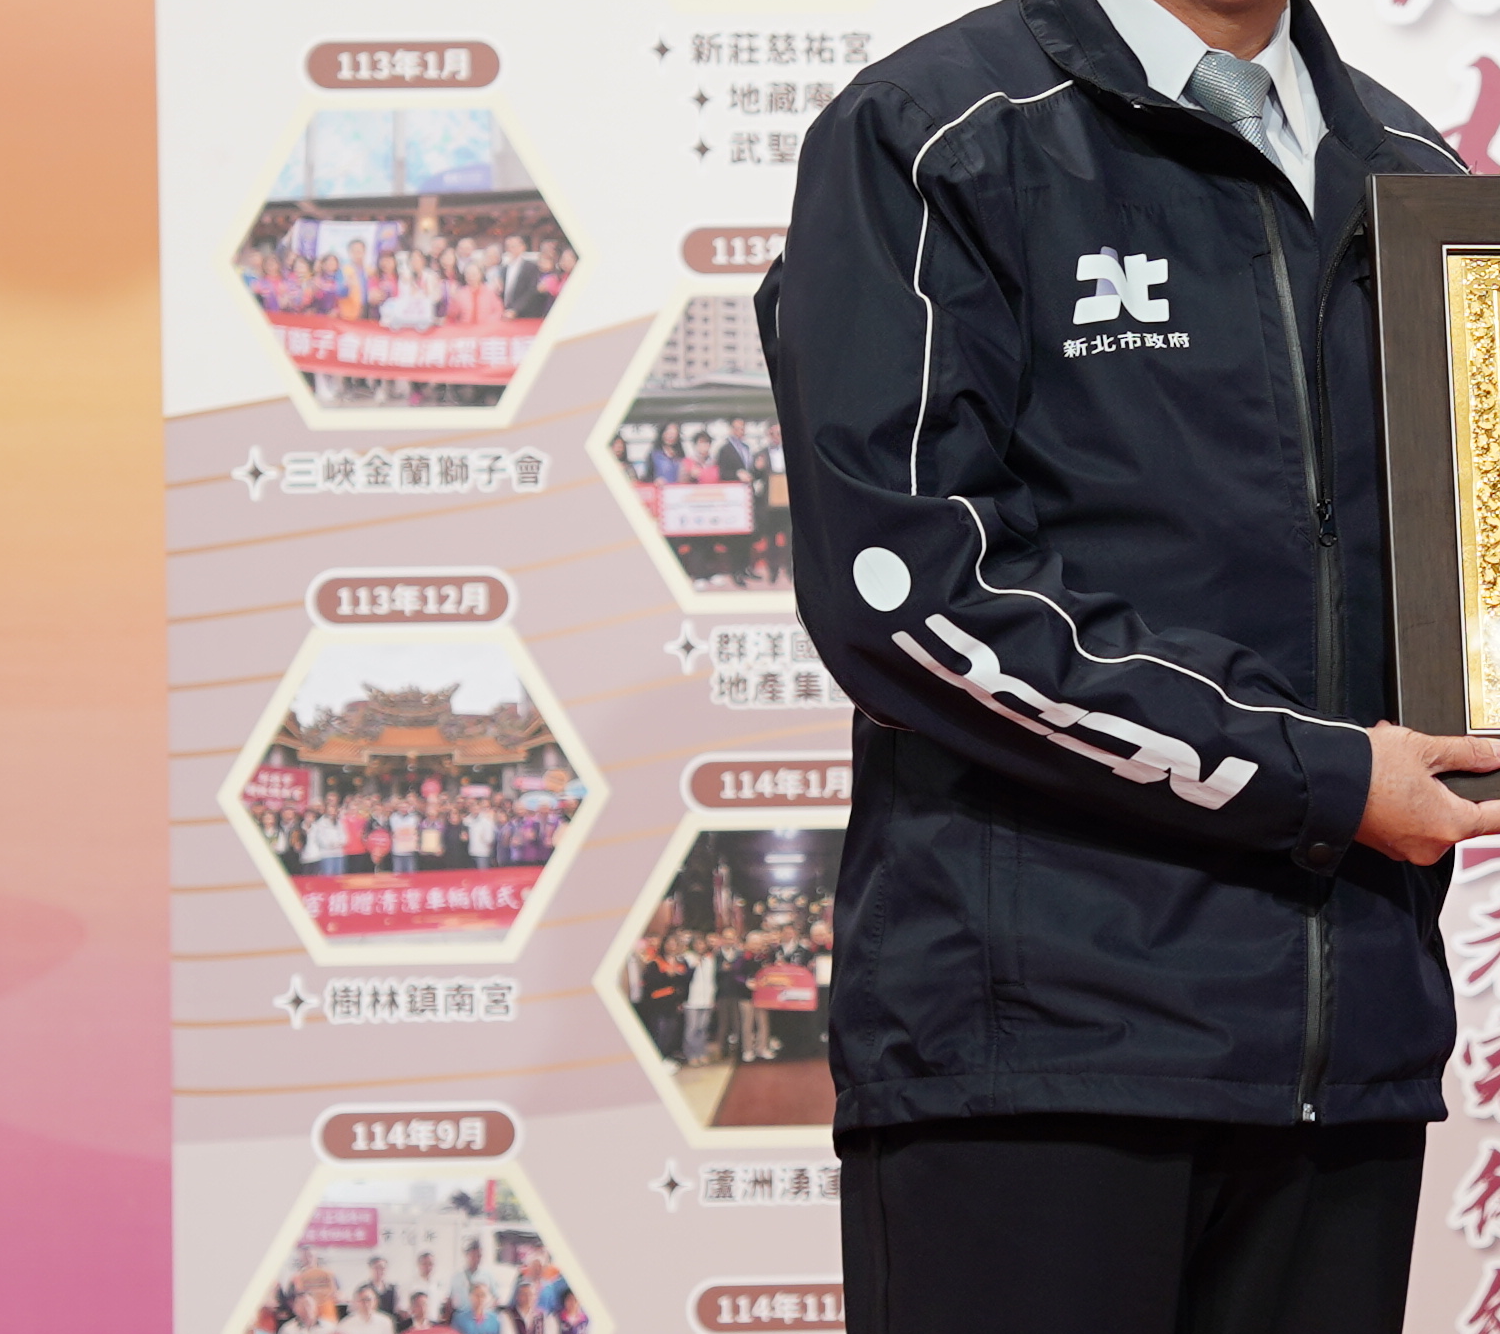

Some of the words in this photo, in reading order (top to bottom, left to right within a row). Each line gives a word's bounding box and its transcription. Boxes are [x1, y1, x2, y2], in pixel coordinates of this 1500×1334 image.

[336, 49, 472, 82] 113年1月
[691, 32, 871, 65] 新莊慈祐宮
[1062, 331, 1190, 359] 新北市政府
[285, 453, 544, 488] 三峽金蘭獅子會
[336, 583, 489, 617] 113年12月
[718, 768, 851, 801] 114年1月
[328, 982, 515, 1019] 樹林鎮南宮
[351, 1117, 487, 1152] 114年9月
[716, 1289, 845, 1325] 114年11
